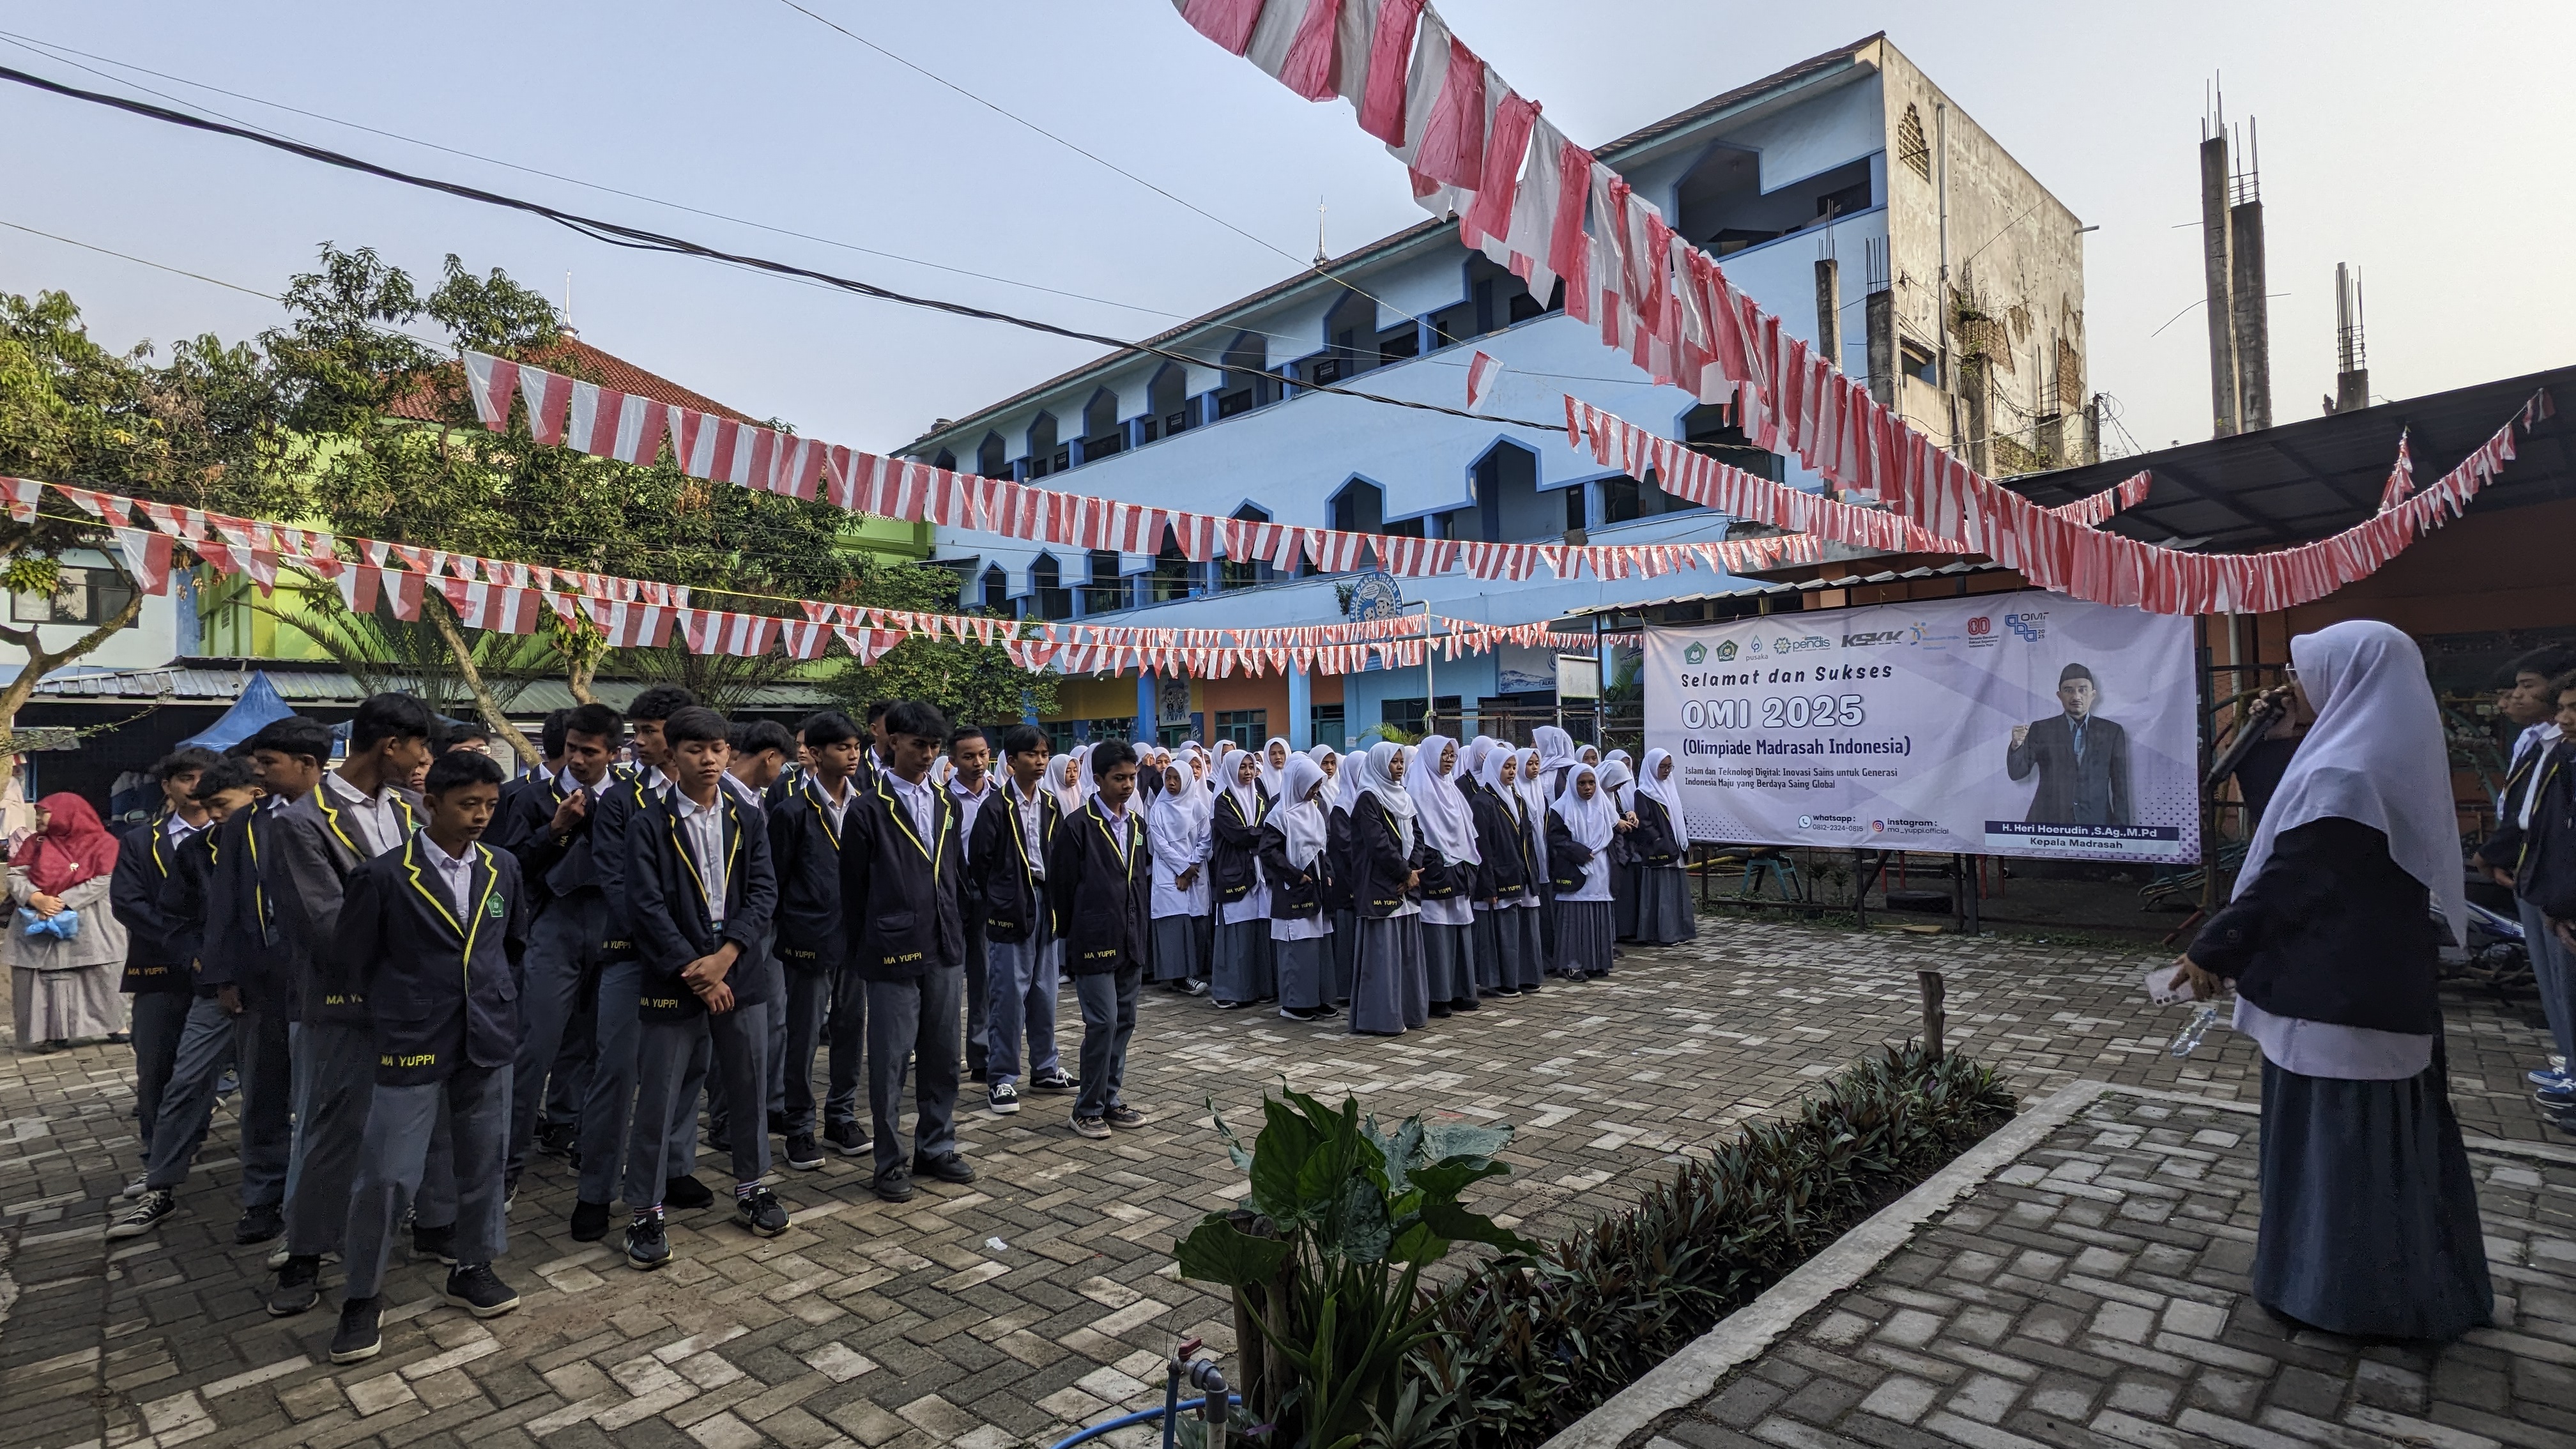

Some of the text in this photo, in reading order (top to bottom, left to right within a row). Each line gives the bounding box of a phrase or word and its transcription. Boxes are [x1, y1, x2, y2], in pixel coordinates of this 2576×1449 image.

[1356, 574, 1377, 593] DARUL
[1968, 617, 1990, 635] 80
[1793, 635, 1830, 652] pendis
[1745, 654, 1768, 662] pusaka
[1682, 664, 1892, 687] Selamat dan Sukses
[1682, 694, 1865, 729] OMI 2025
[1683, 735, 1911, 758] (Olimpiade Madrasah Indonesia)
[1685, 767, 1703, 775] Islam
[1718, 767, 1754, 778] Teknologi
[1755, 767, 1781, 778] Digital:
[1783, 768, 1811, 776] Inovasi
[1813, 768, 1834, 776] Sains
[1836, 768, 1860, 776] untuk
[1862, 768, 1897, 777] Generasi
[1685, 778, 1836, 790] Indonesia Maju yang Berdaya Saing Global
[1812, 824, 1864, 832] 0812-2324-0815
[2002, 824, 2012, 832] H.
[2014, 824, 2035, 832] Heri
[2037, 825, 2088, 835] Hoerudin
[2030, 838, 2123, 849] Kepala Madrasah
[795, 950, 816, 959] YUPPI
[884, 952, 922, 965] MA YUPPI
[1097, 949, 1117, 958] YUPPI
[128, 967, 140, 976] MA
[326, 995, 345, 1004] MA
[653, 998, 678, 1008] YUPPI
[399, 1054, 436, 1067] YUPPI
